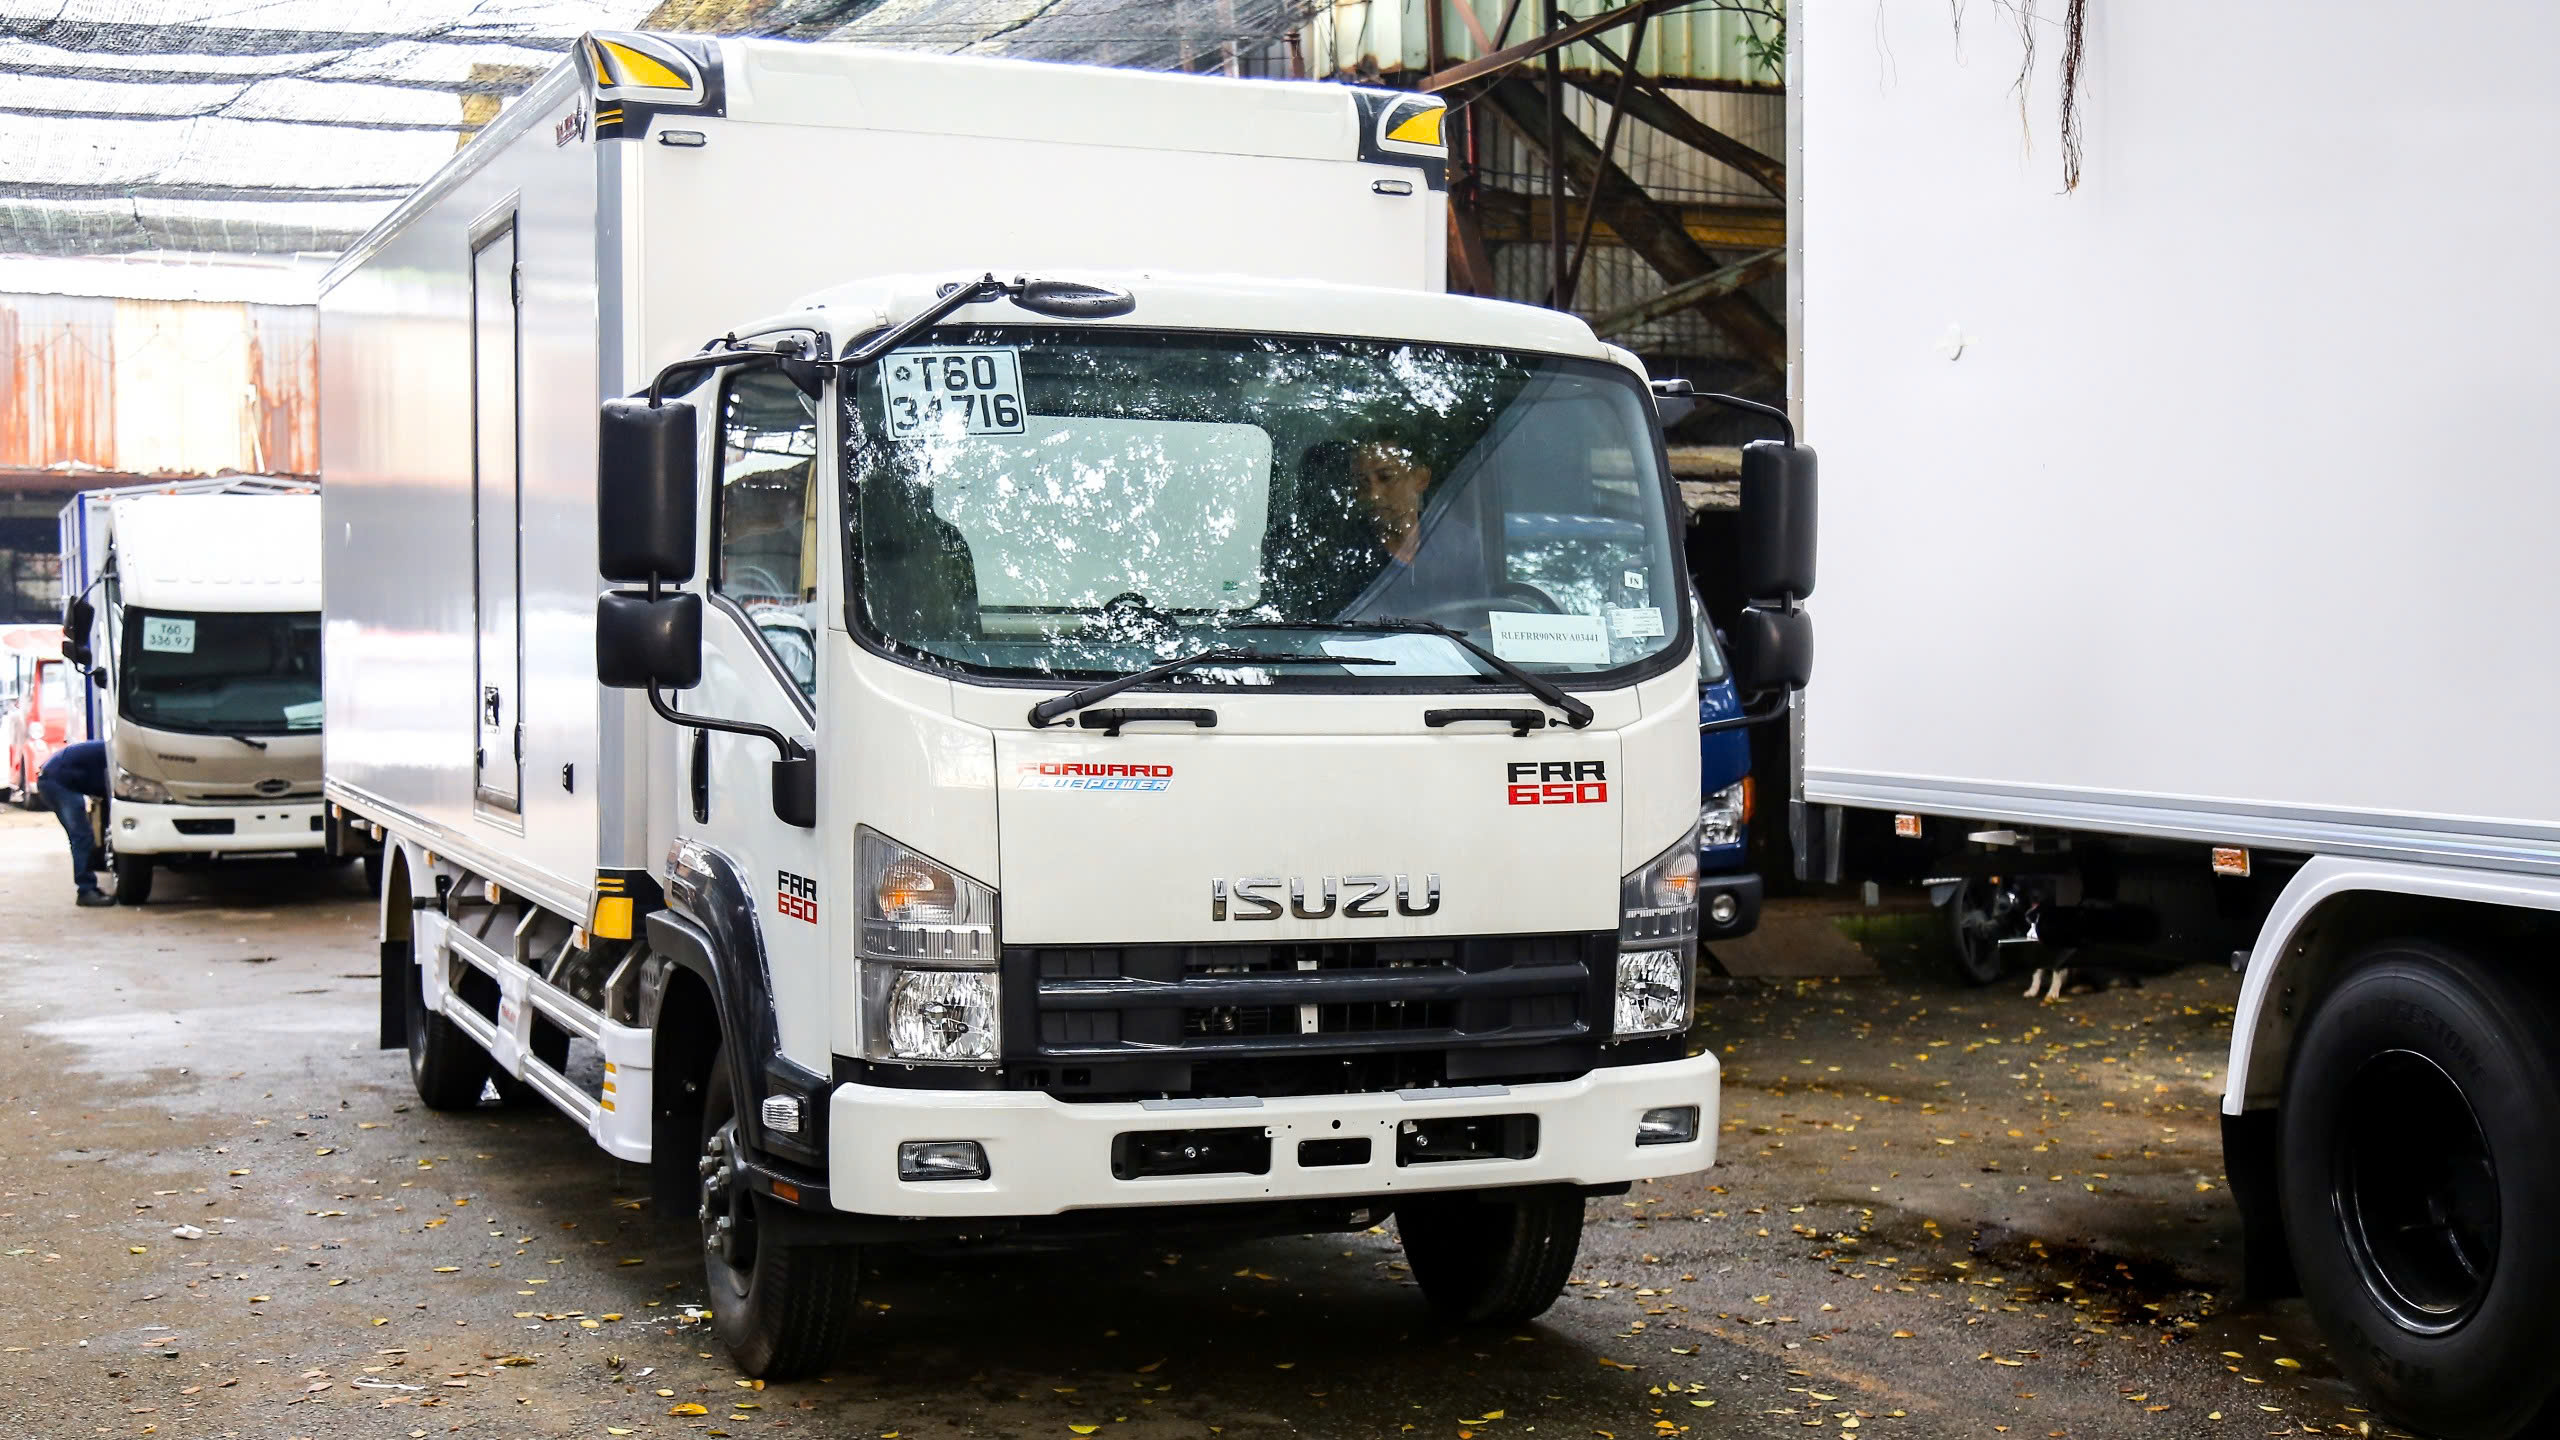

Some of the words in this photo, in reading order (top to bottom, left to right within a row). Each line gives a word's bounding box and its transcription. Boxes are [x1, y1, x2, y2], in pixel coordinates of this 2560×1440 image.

[912, 355, 997, 392] T60
[1018, 762, 1174, 778] FORWARD
[1507, 760, 1607, 783] FRR
[1507, 782, 1608, 806] 650
[778, 869, 818, 902] FRR
[1211, 873, 1441, 922] ISUZU
[778, 892, 818, 925] 650
